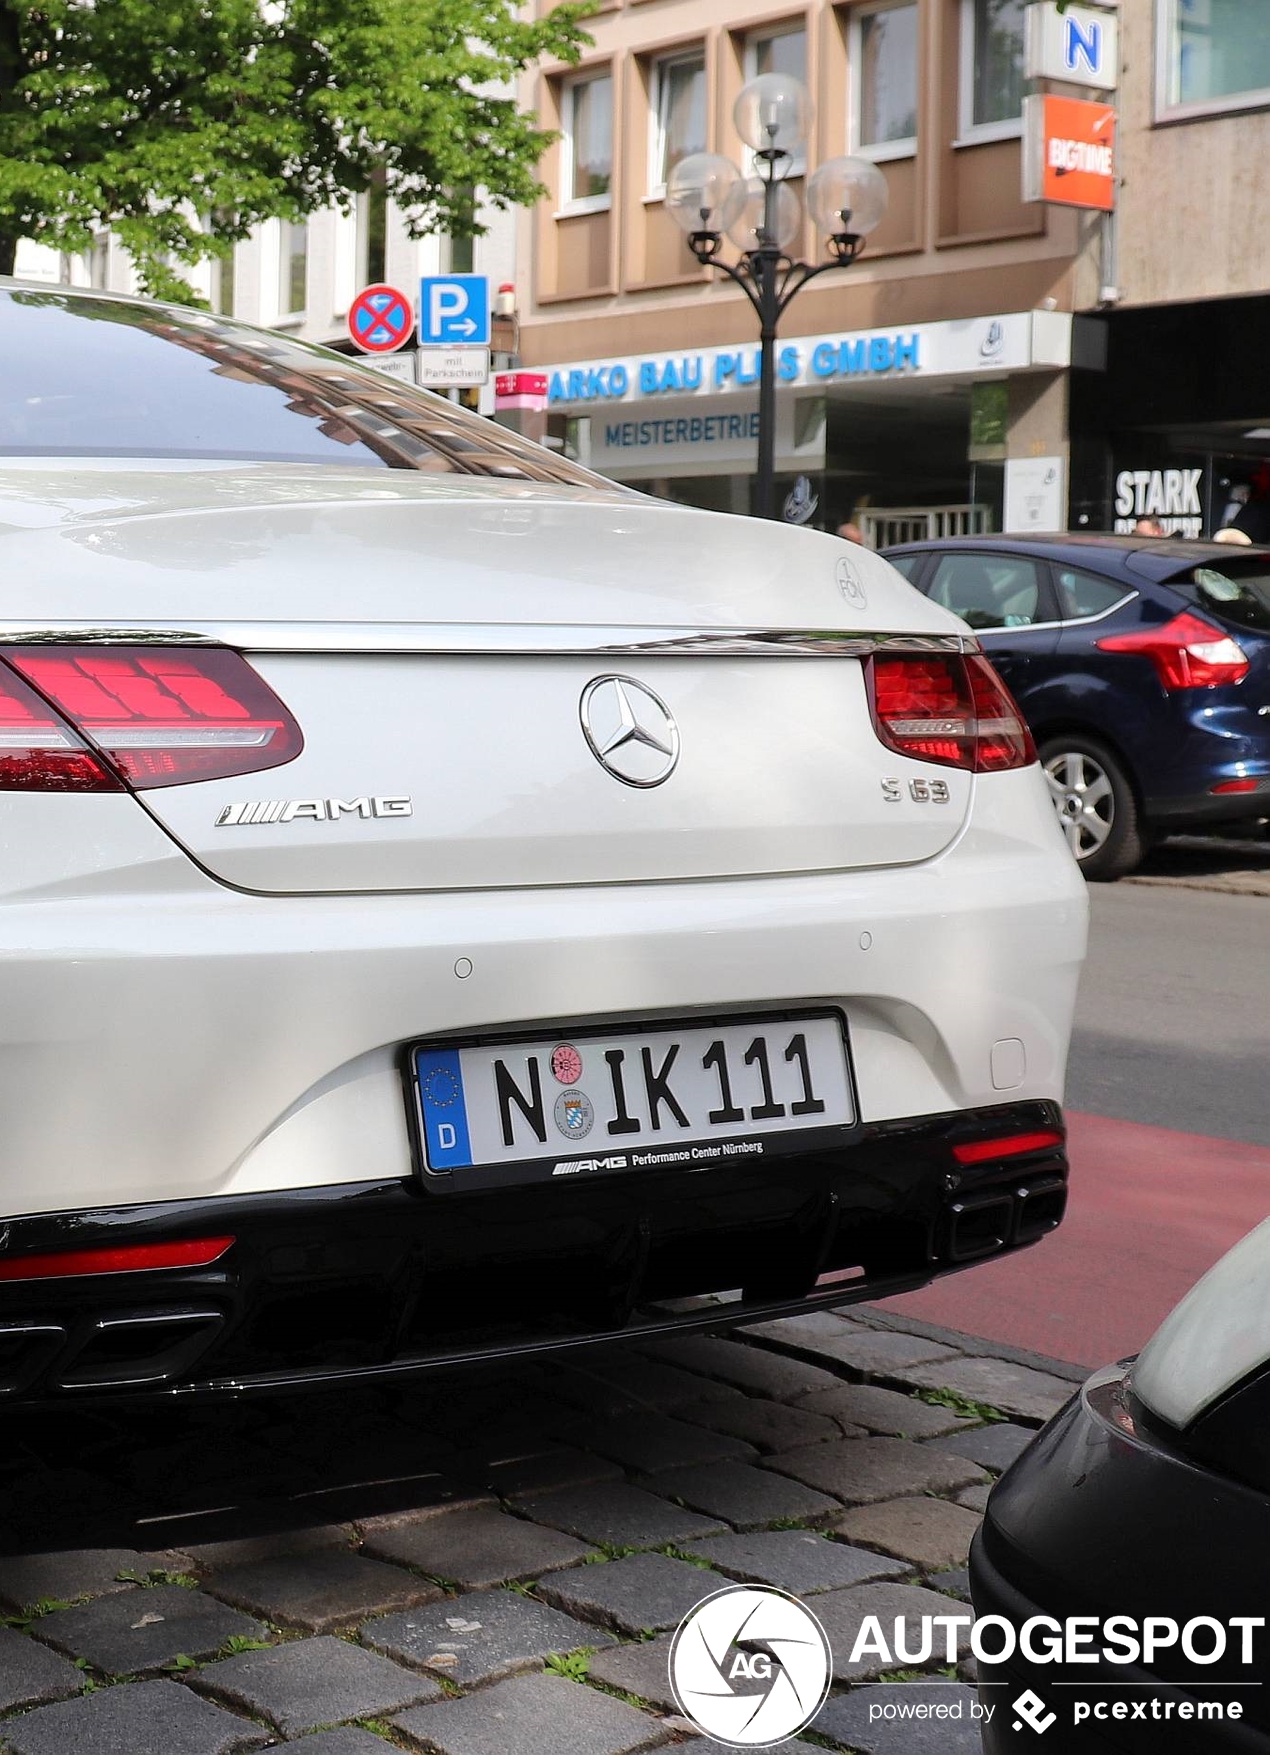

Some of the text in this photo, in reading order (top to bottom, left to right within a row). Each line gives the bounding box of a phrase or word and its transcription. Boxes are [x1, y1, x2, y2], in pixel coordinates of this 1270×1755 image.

[1065, 15, 1103, 73] N
[1049, 138, 1112, 174] BIGTIME
[431, 283, 468, 336] P
[425, 367, 483, 377] Parkschein
[640, 356, 703, 394] BAU
[812, 333, 920, 377] GMBH
[606, 412, 761, 446] MEISTERBETRIE
[1114, 469, 1202, 516] STARK
[881, 777, 950, 804] S 63
[281, 796, 413, 822] AMG
[494, 1057, 546, 1146] N
[439, 1124, 457, 1149] D
[576, 1141, 764, 1172] AMG Performance Center Nürnberg
